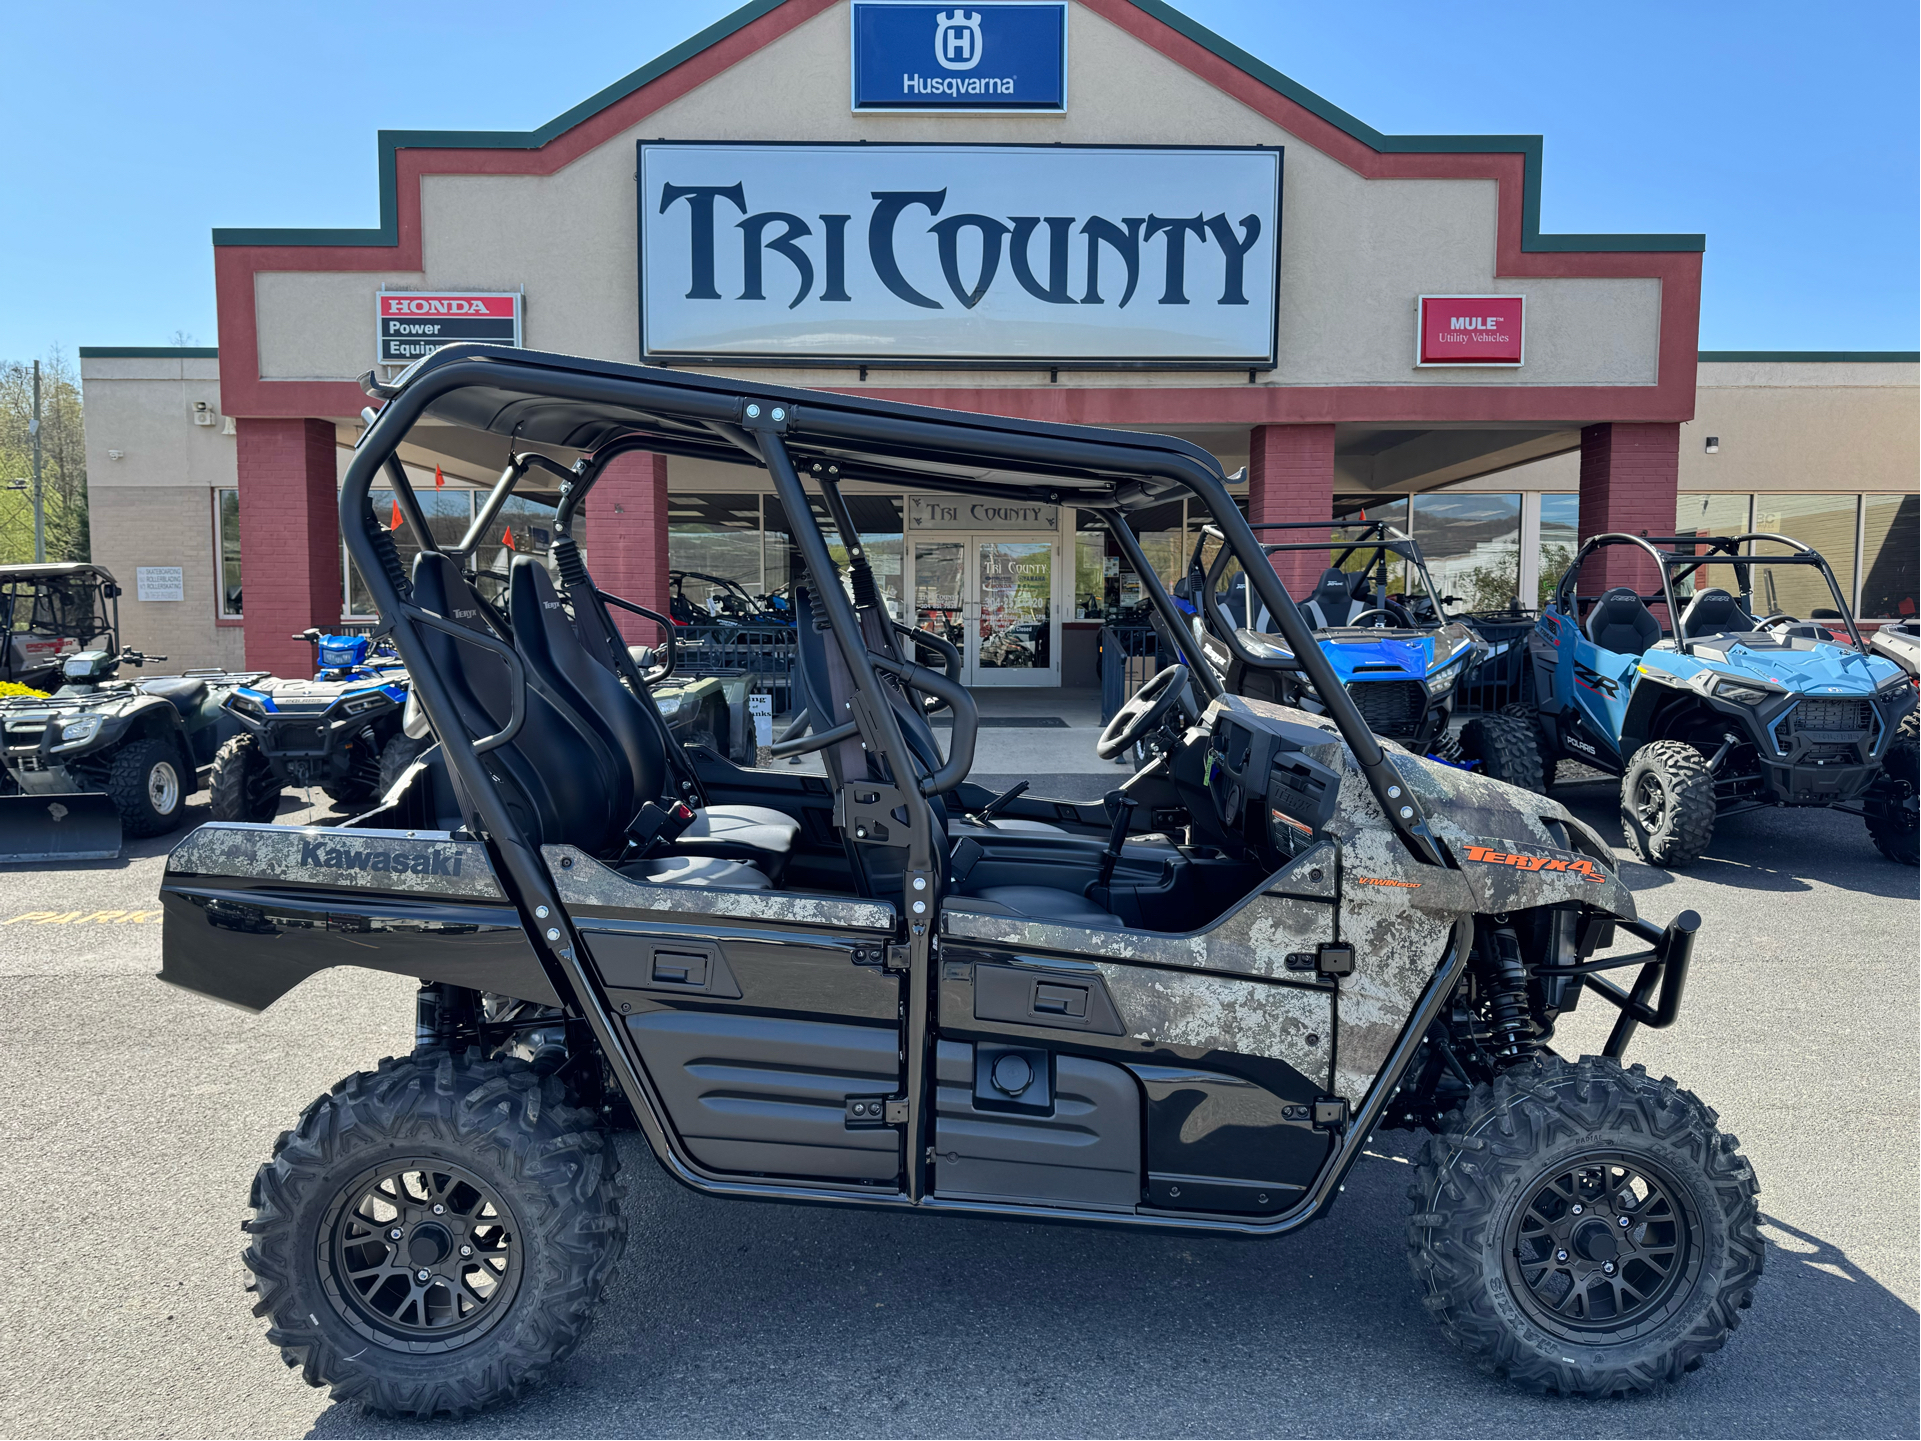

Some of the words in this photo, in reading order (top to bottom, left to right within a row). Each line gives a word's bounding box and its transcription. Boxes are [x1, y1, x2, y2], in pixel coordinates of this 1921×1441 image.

[903, 73, 1014, 97] Husqvarna
[658, 180, 852, 310] TRI
[868, 186, 1262, 310] COUNTY
[388, 300, 490, 314] HONDA
[389, 321, 441, 334] Power
[1439, 333, 1469, 344] Utility
[1471, 332, 1509, 342] Vehicles
[926, 503, 957, 521] TRI
[970, 503, 1042, 521] COUNTY
[1567, 735, 1596, 755] POLARIS
[300, 841, 464, 876] Kawasaki
[1, 910, 164, 925] PARK
